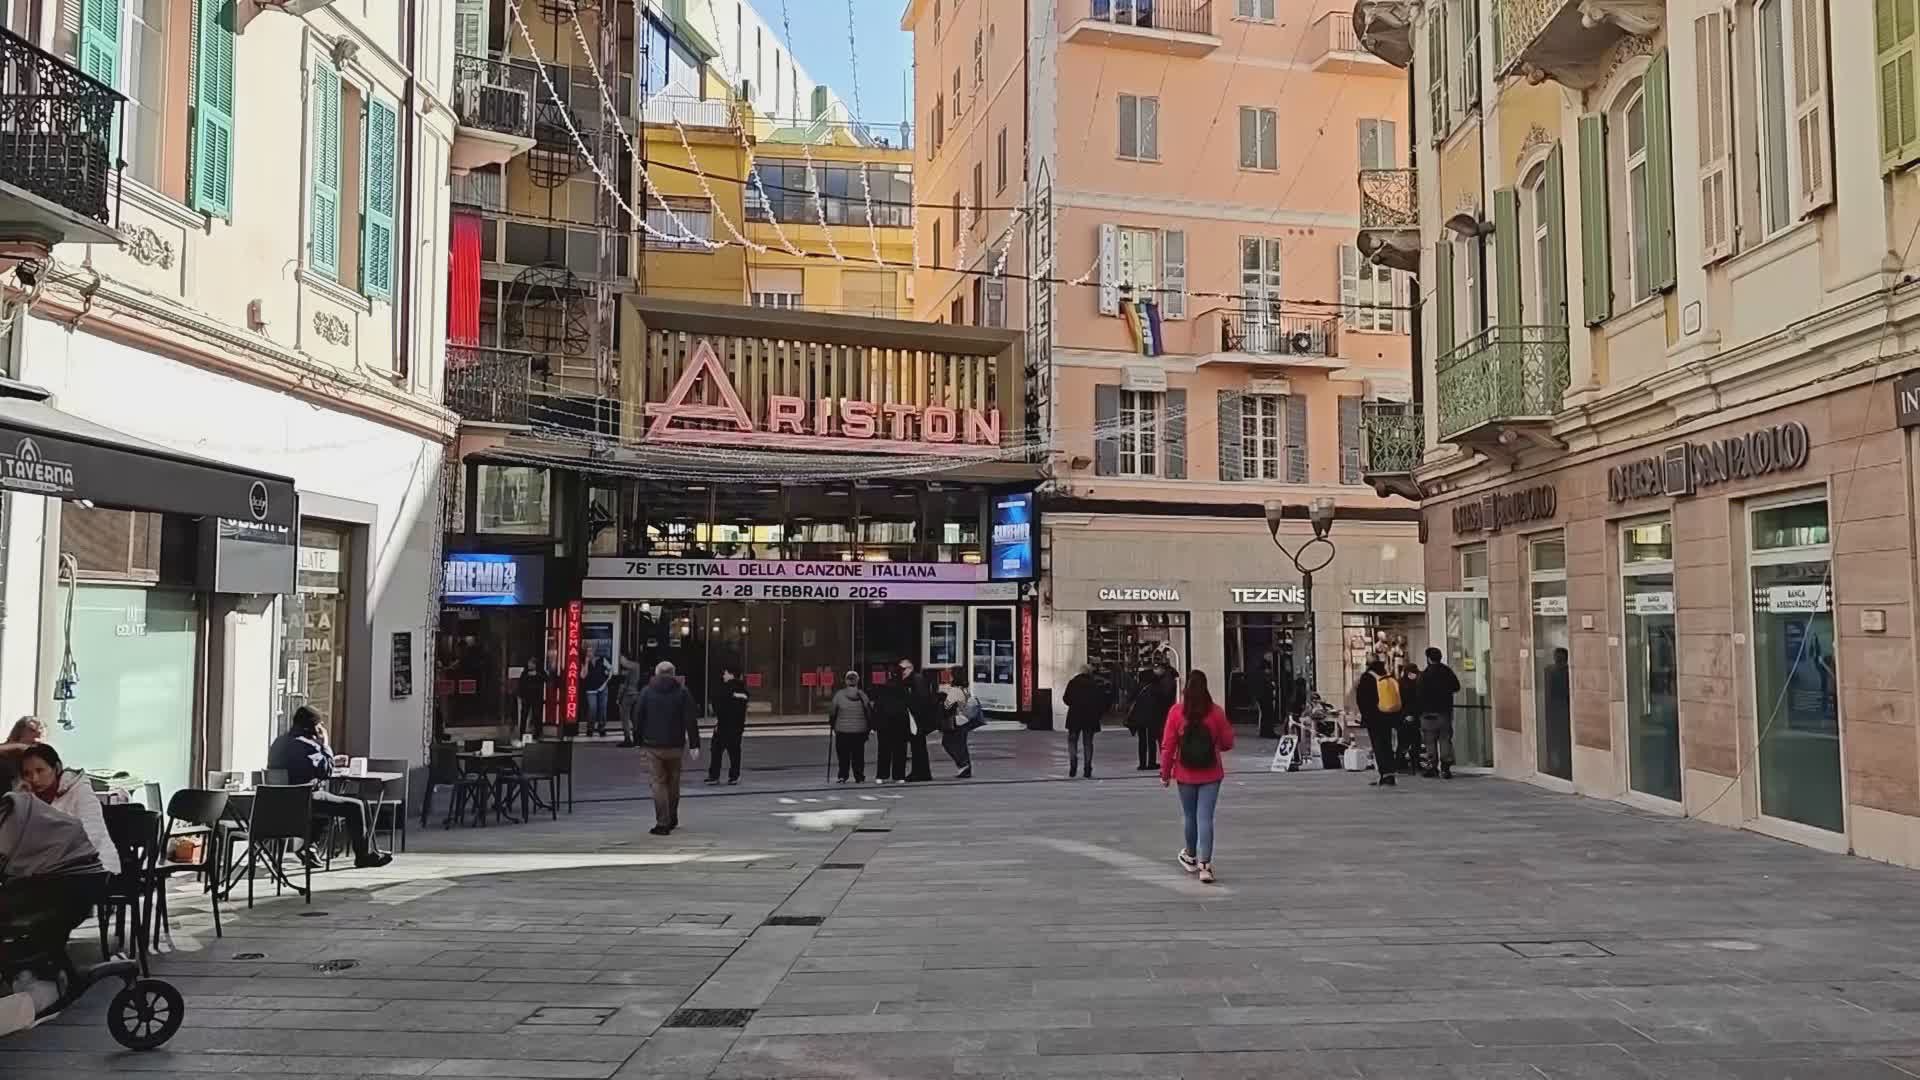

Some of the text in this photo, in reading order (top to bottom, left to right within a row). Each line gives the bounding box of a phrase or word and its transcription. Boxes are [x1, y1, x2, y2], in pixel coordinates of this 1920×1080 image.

[645, 339, 1001, 446] ARISTON
[1901, 387, 1920, 414] IN
[1693, 421, 1809, 488] SANPAOLO
[6, 459, 73, 485] TAVERNA
[657, 562, 730, 576] FESTIVAL
[739, 563, 786, 577] DELLA
[795, 563, 863, 577] CANZONE
[872, 564, 937, 578] ITALIANA
[763, 585, 839, 598] FEBBRAIO
[849, 586, 888, 598] 2026
[1099, 588, 1180, 600] CALZEDONIA
[287, 612, 331, 629] ALA
[567, 604, 579, 719] CINEMA ARISTON
